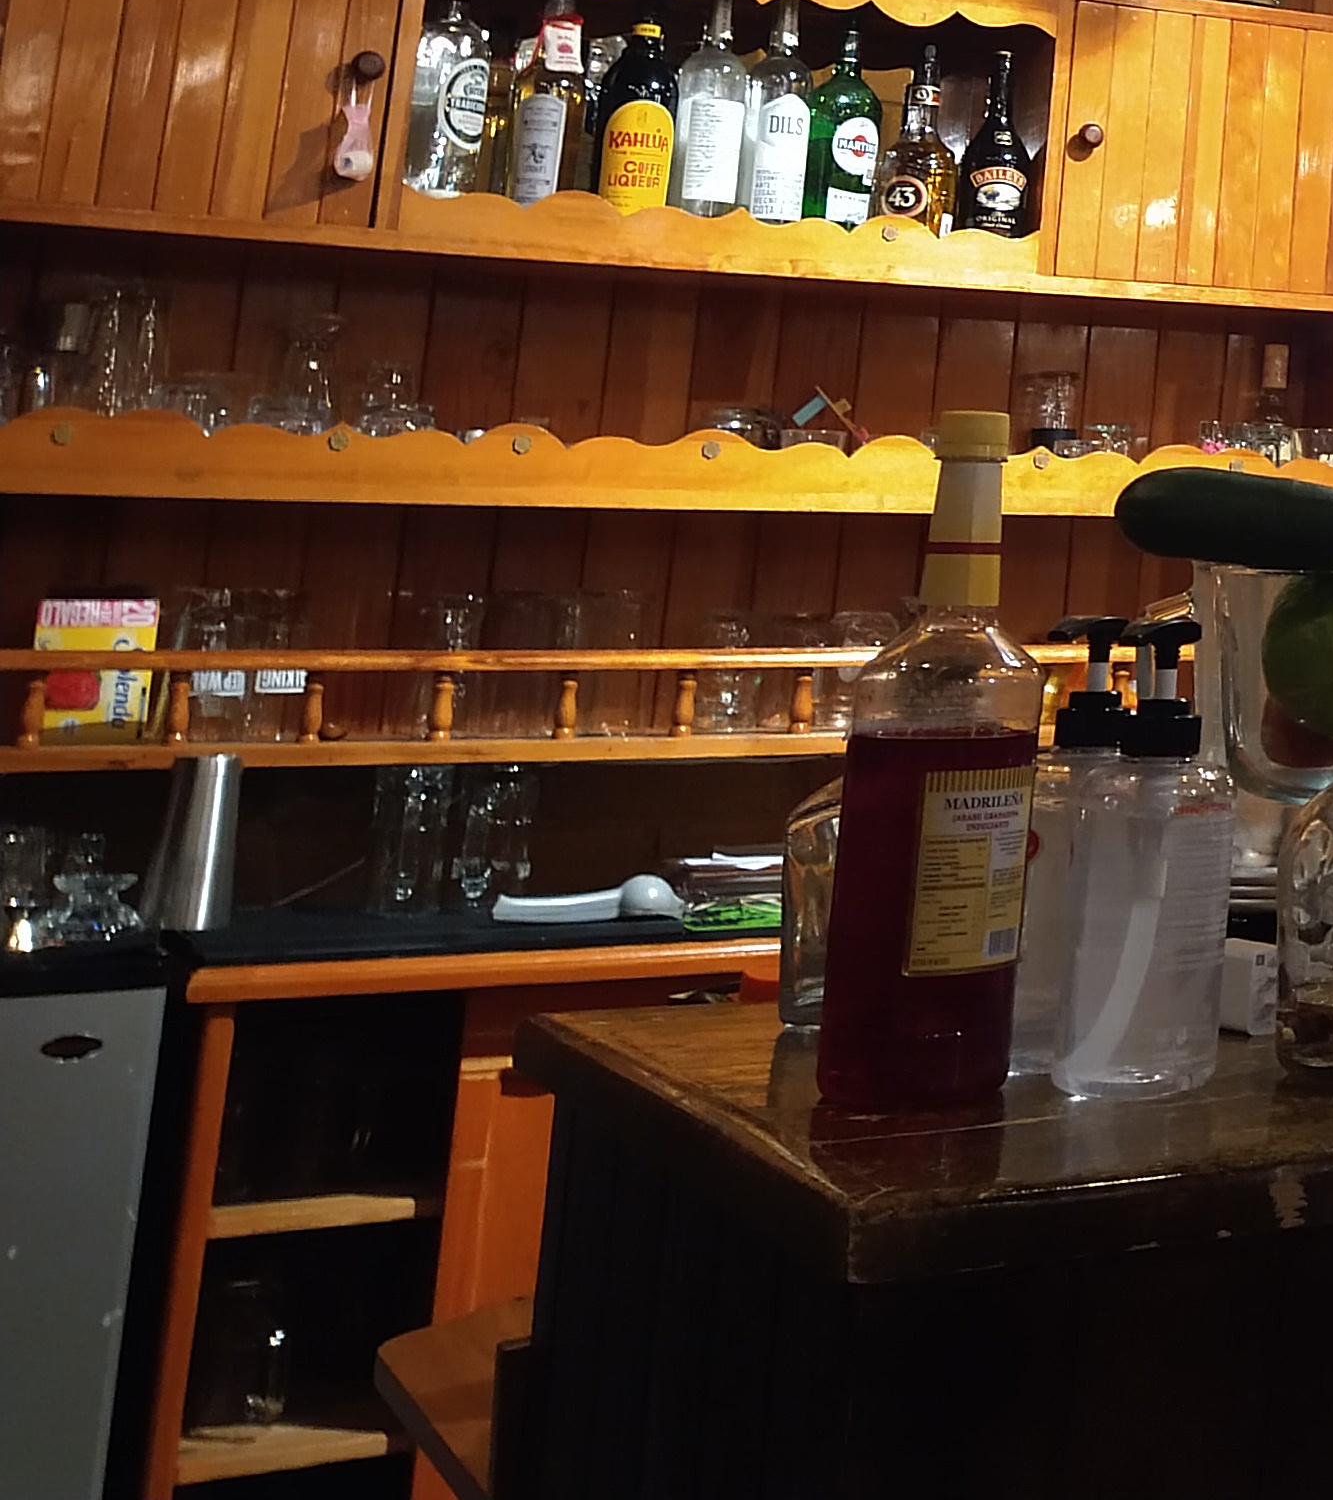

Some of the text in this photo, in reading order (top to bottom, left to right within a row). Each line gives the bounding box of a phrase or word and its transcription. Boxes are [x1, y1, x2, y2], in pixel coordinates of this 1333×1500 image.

[608, 129, 669, 152] KAHLÚA
[974, 169, 1025, 187] BAILEYS
[887, 186, 917, 208] 43
